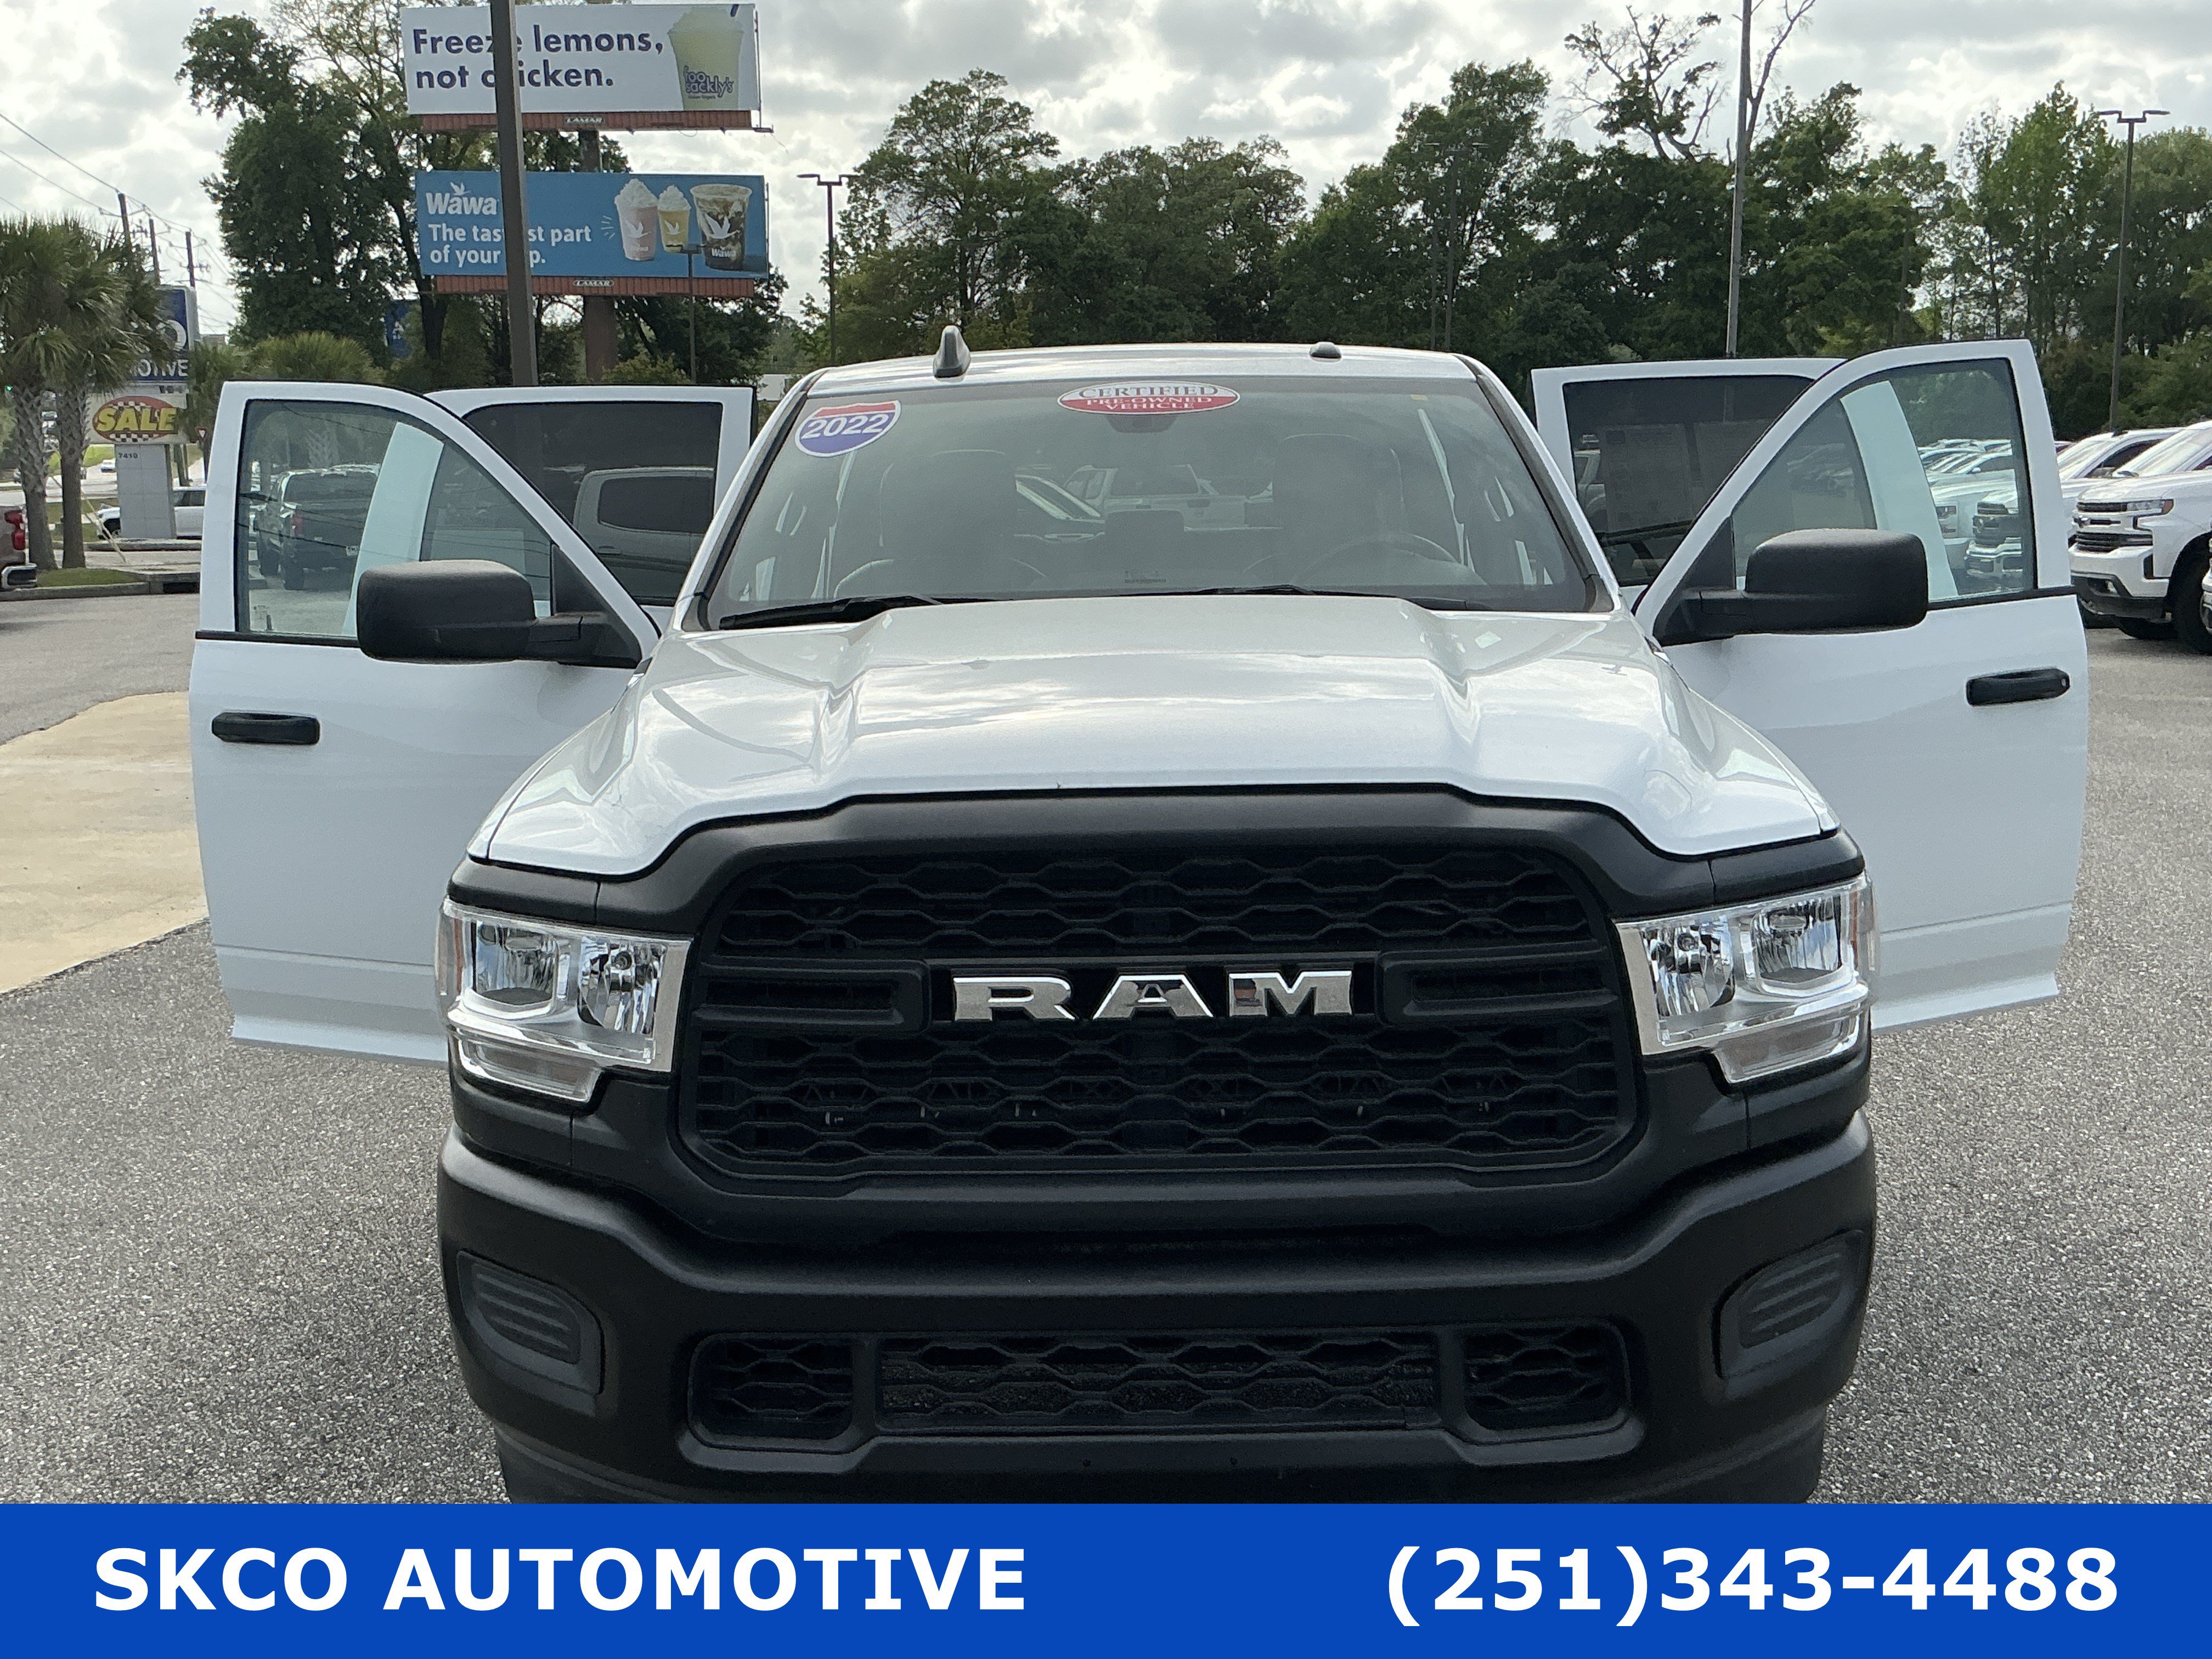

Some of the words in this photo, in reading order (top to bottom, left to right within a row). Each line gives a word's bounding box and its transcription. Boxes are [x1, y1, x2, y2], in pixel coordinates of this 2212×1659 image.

[534, 25, 663, 54] lemons,
[417, 66, 469, 88] not
[481, 59, 613, 88] cicken.
[426, 193, 497, 215] Wawa
[428, 223, 466, 241] The
[473, 225, 545, 242] tasst
[550, 225, 592, 246] part
[430, 245, 451, 263] of
[455, 249, 501, 268] your
[712, 247, 736, 257] Wawa
[1079, 386, 1218, 398] CERTIFIED
[1086, 397, 1212, 405] PRE-OWNED
[96, 407, 177, 432] SALE
[800, 414, 889, 439] 2022
[953, 970, 1353, 1020] RAM
